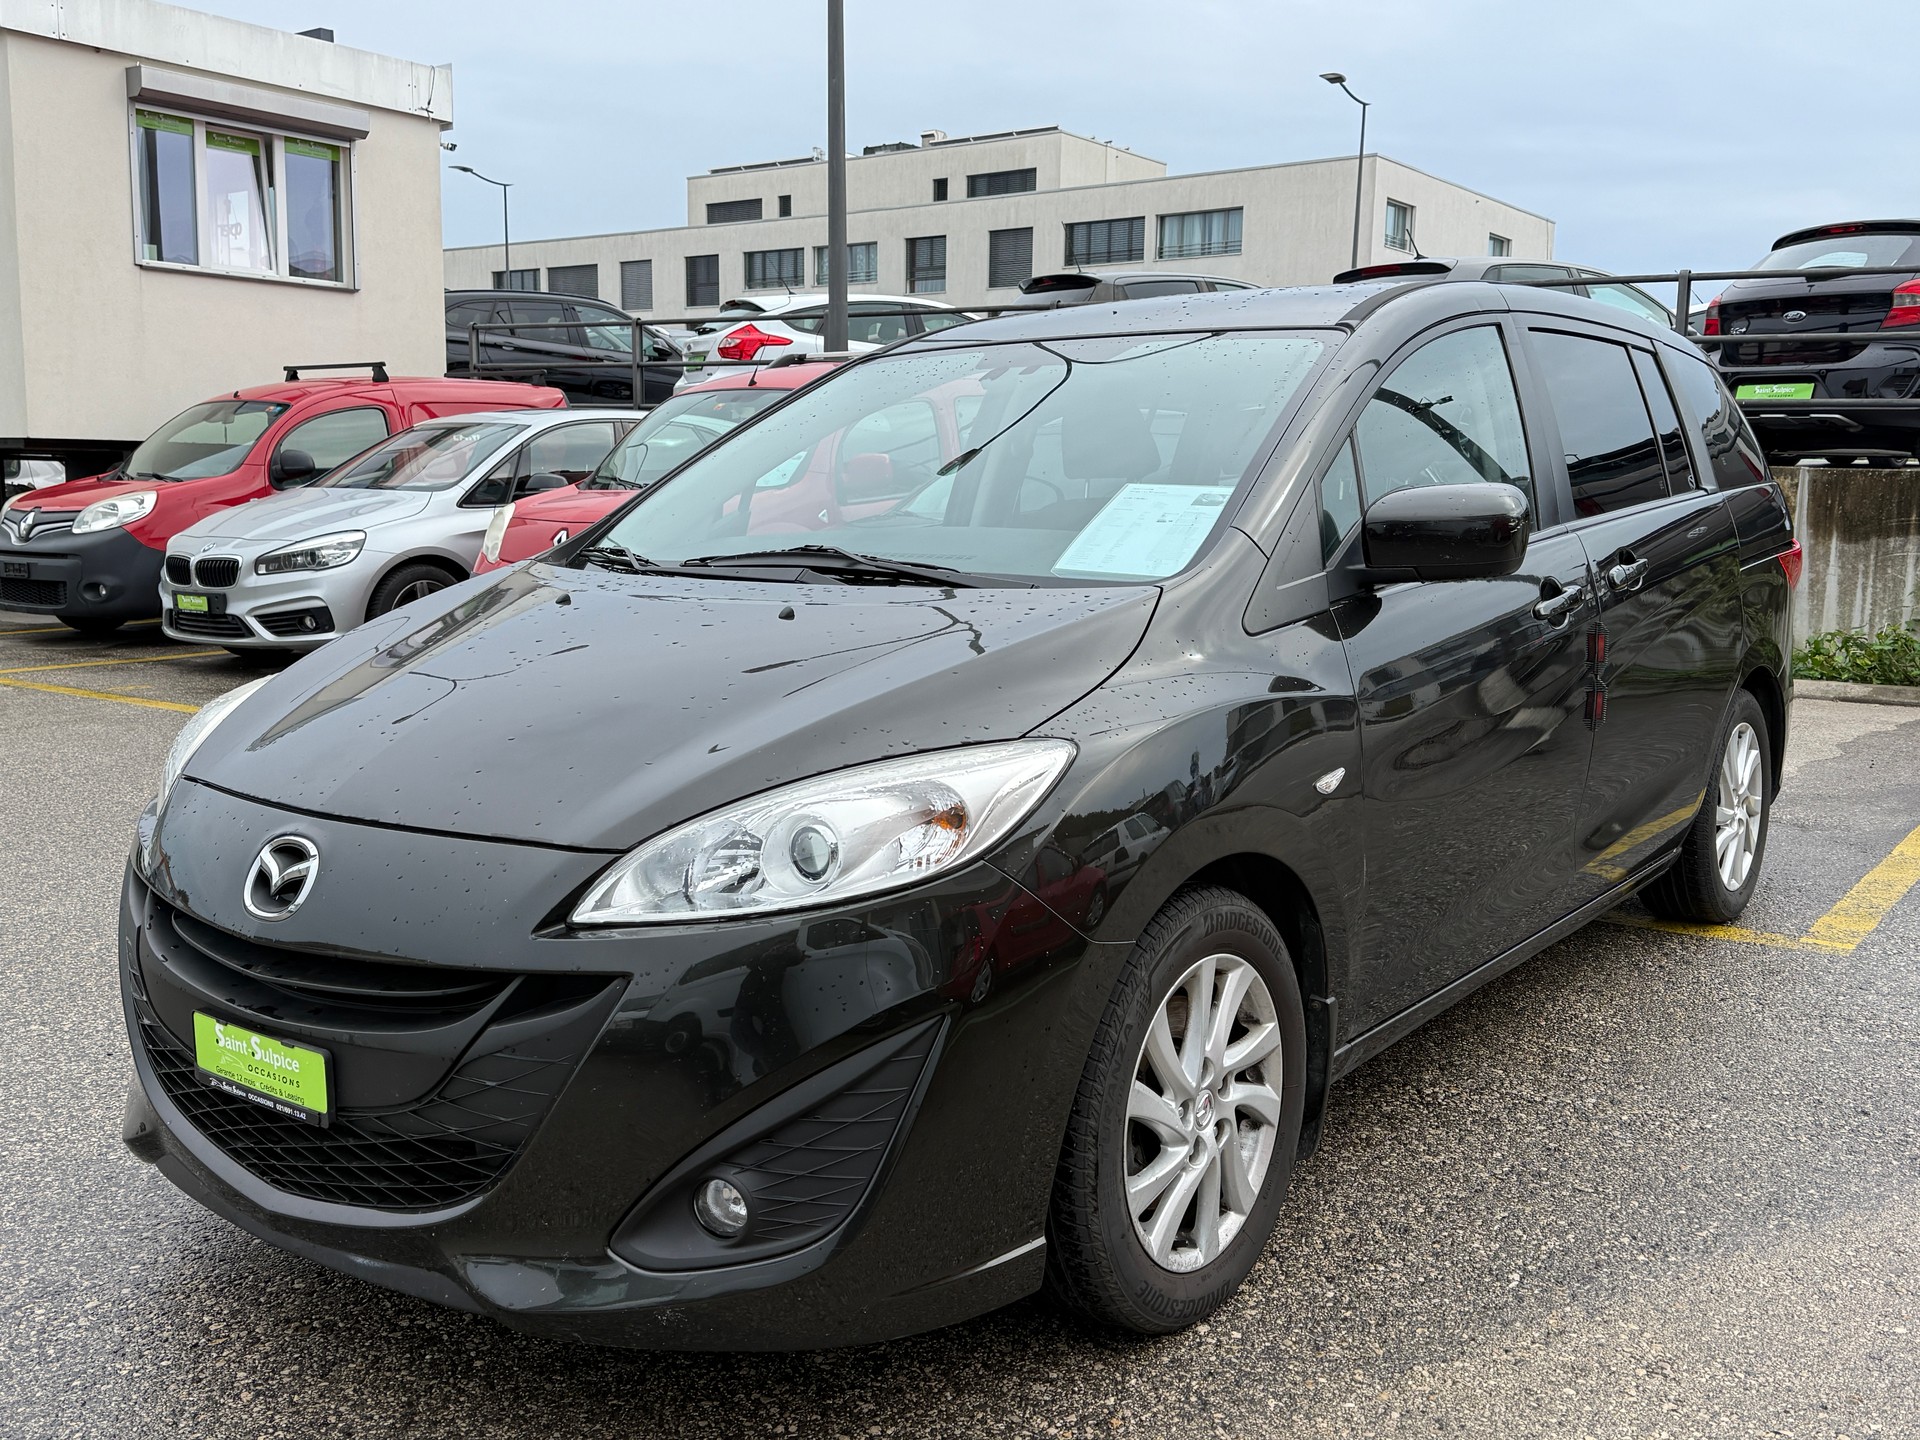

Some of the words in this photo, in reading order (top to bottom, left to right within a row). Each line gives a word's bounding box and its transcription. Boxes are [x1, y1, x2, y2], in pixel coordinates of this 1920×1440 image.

[1202, 910, 1284, 962] BRIDGESTONE
[236, 1072, 244, 1082] 12
[243, 1076, 257, 1087] mois
[284, 1090, 305, 1106] Leasing
[247, 1064, 301, 1088] OCCASIONS
[247, 1093, 274, 1108] OCCASIONS
[1134, 1279, 1232, 1320] BRIDGESTONE
